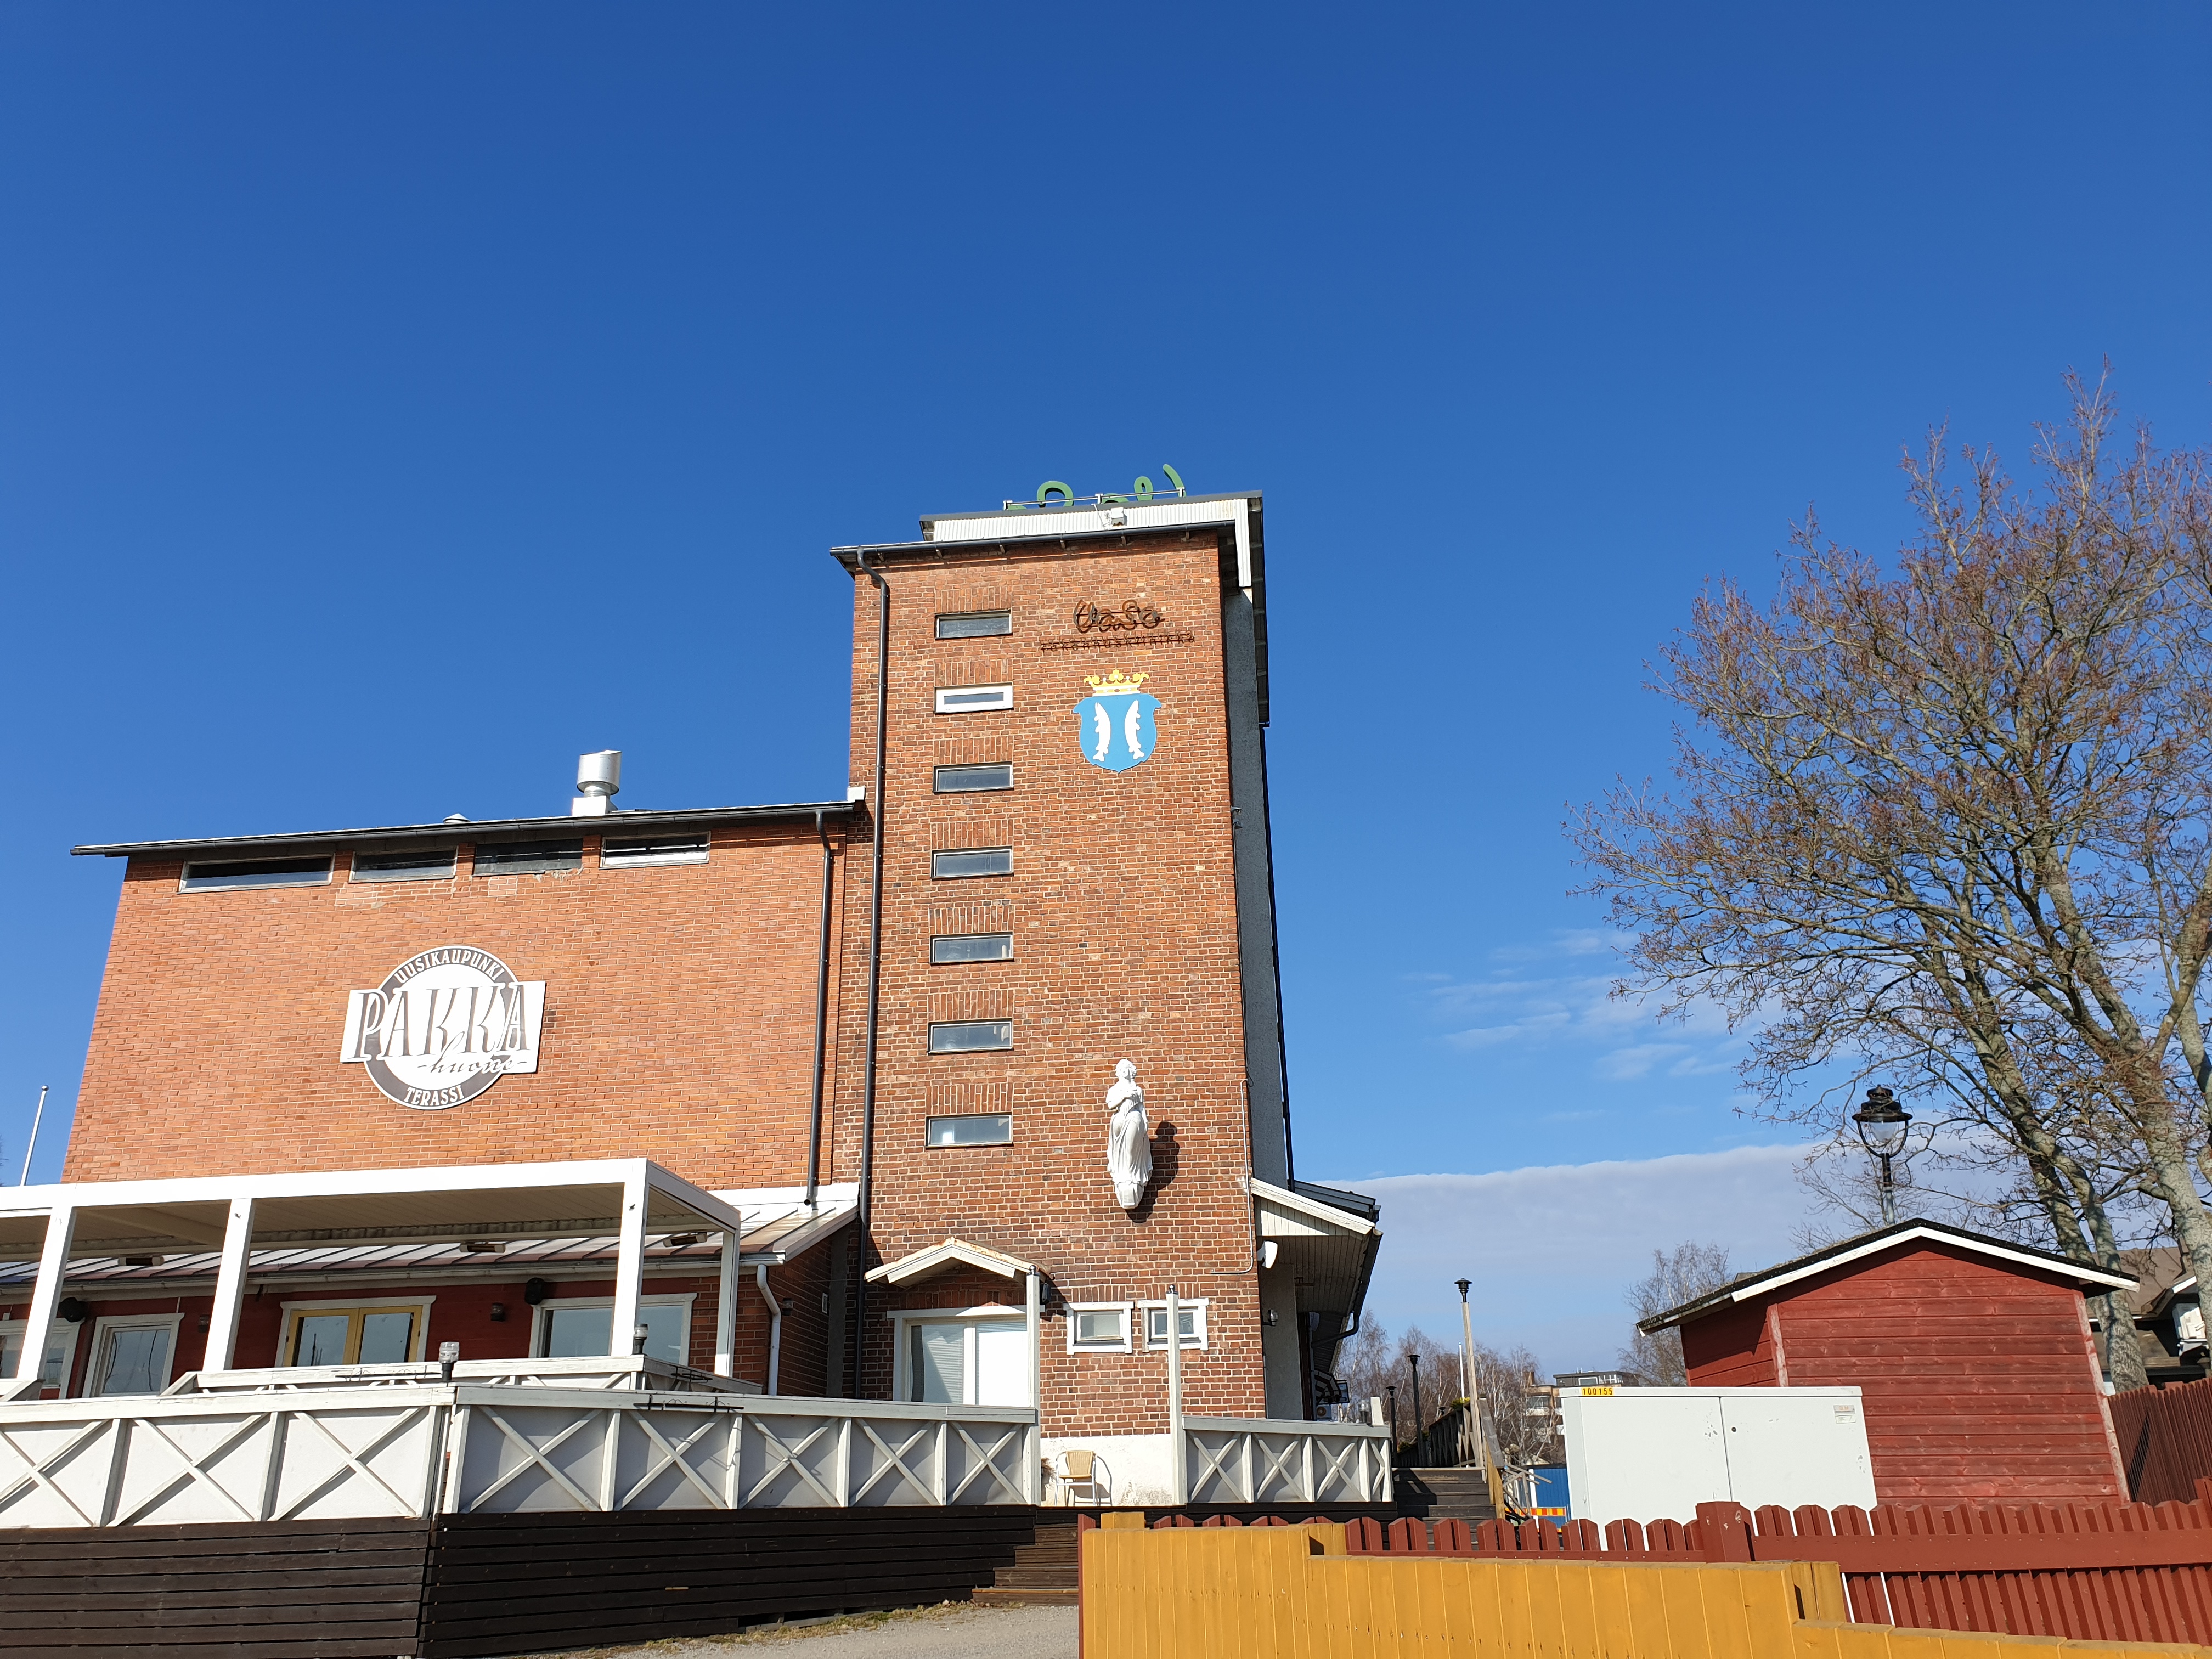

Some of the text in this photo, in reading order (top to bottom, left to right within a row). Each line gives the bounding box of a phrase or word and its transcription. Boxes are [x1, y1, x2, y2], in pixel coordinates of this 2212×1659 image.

[394, 949, 505, 984] UUSIKAUPUNKI
[347, 985, 531, 1059] PAKKA
[404, 1085, 465, 1106] TERASSI
